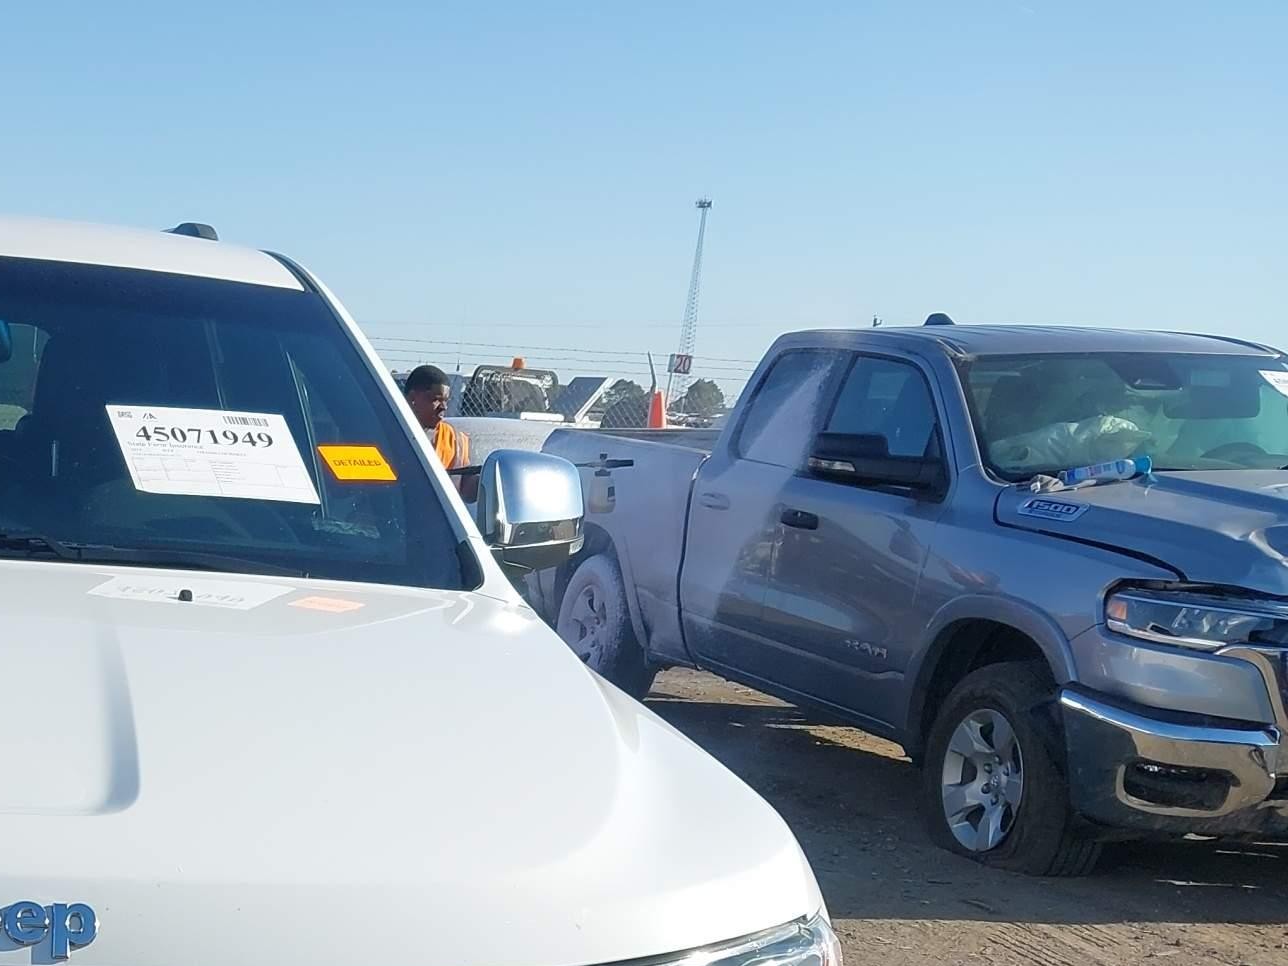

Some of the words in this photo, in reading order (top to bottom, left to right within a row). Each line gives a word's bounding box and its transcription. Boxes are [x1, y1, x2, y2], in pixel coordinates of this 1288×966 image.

[674, 355, 691, 373] 20
[135, 425, 274, 448] 45071949
[332, 459, 382, 467] DETAILED
[1031, 500, 1077, 515] 1500
